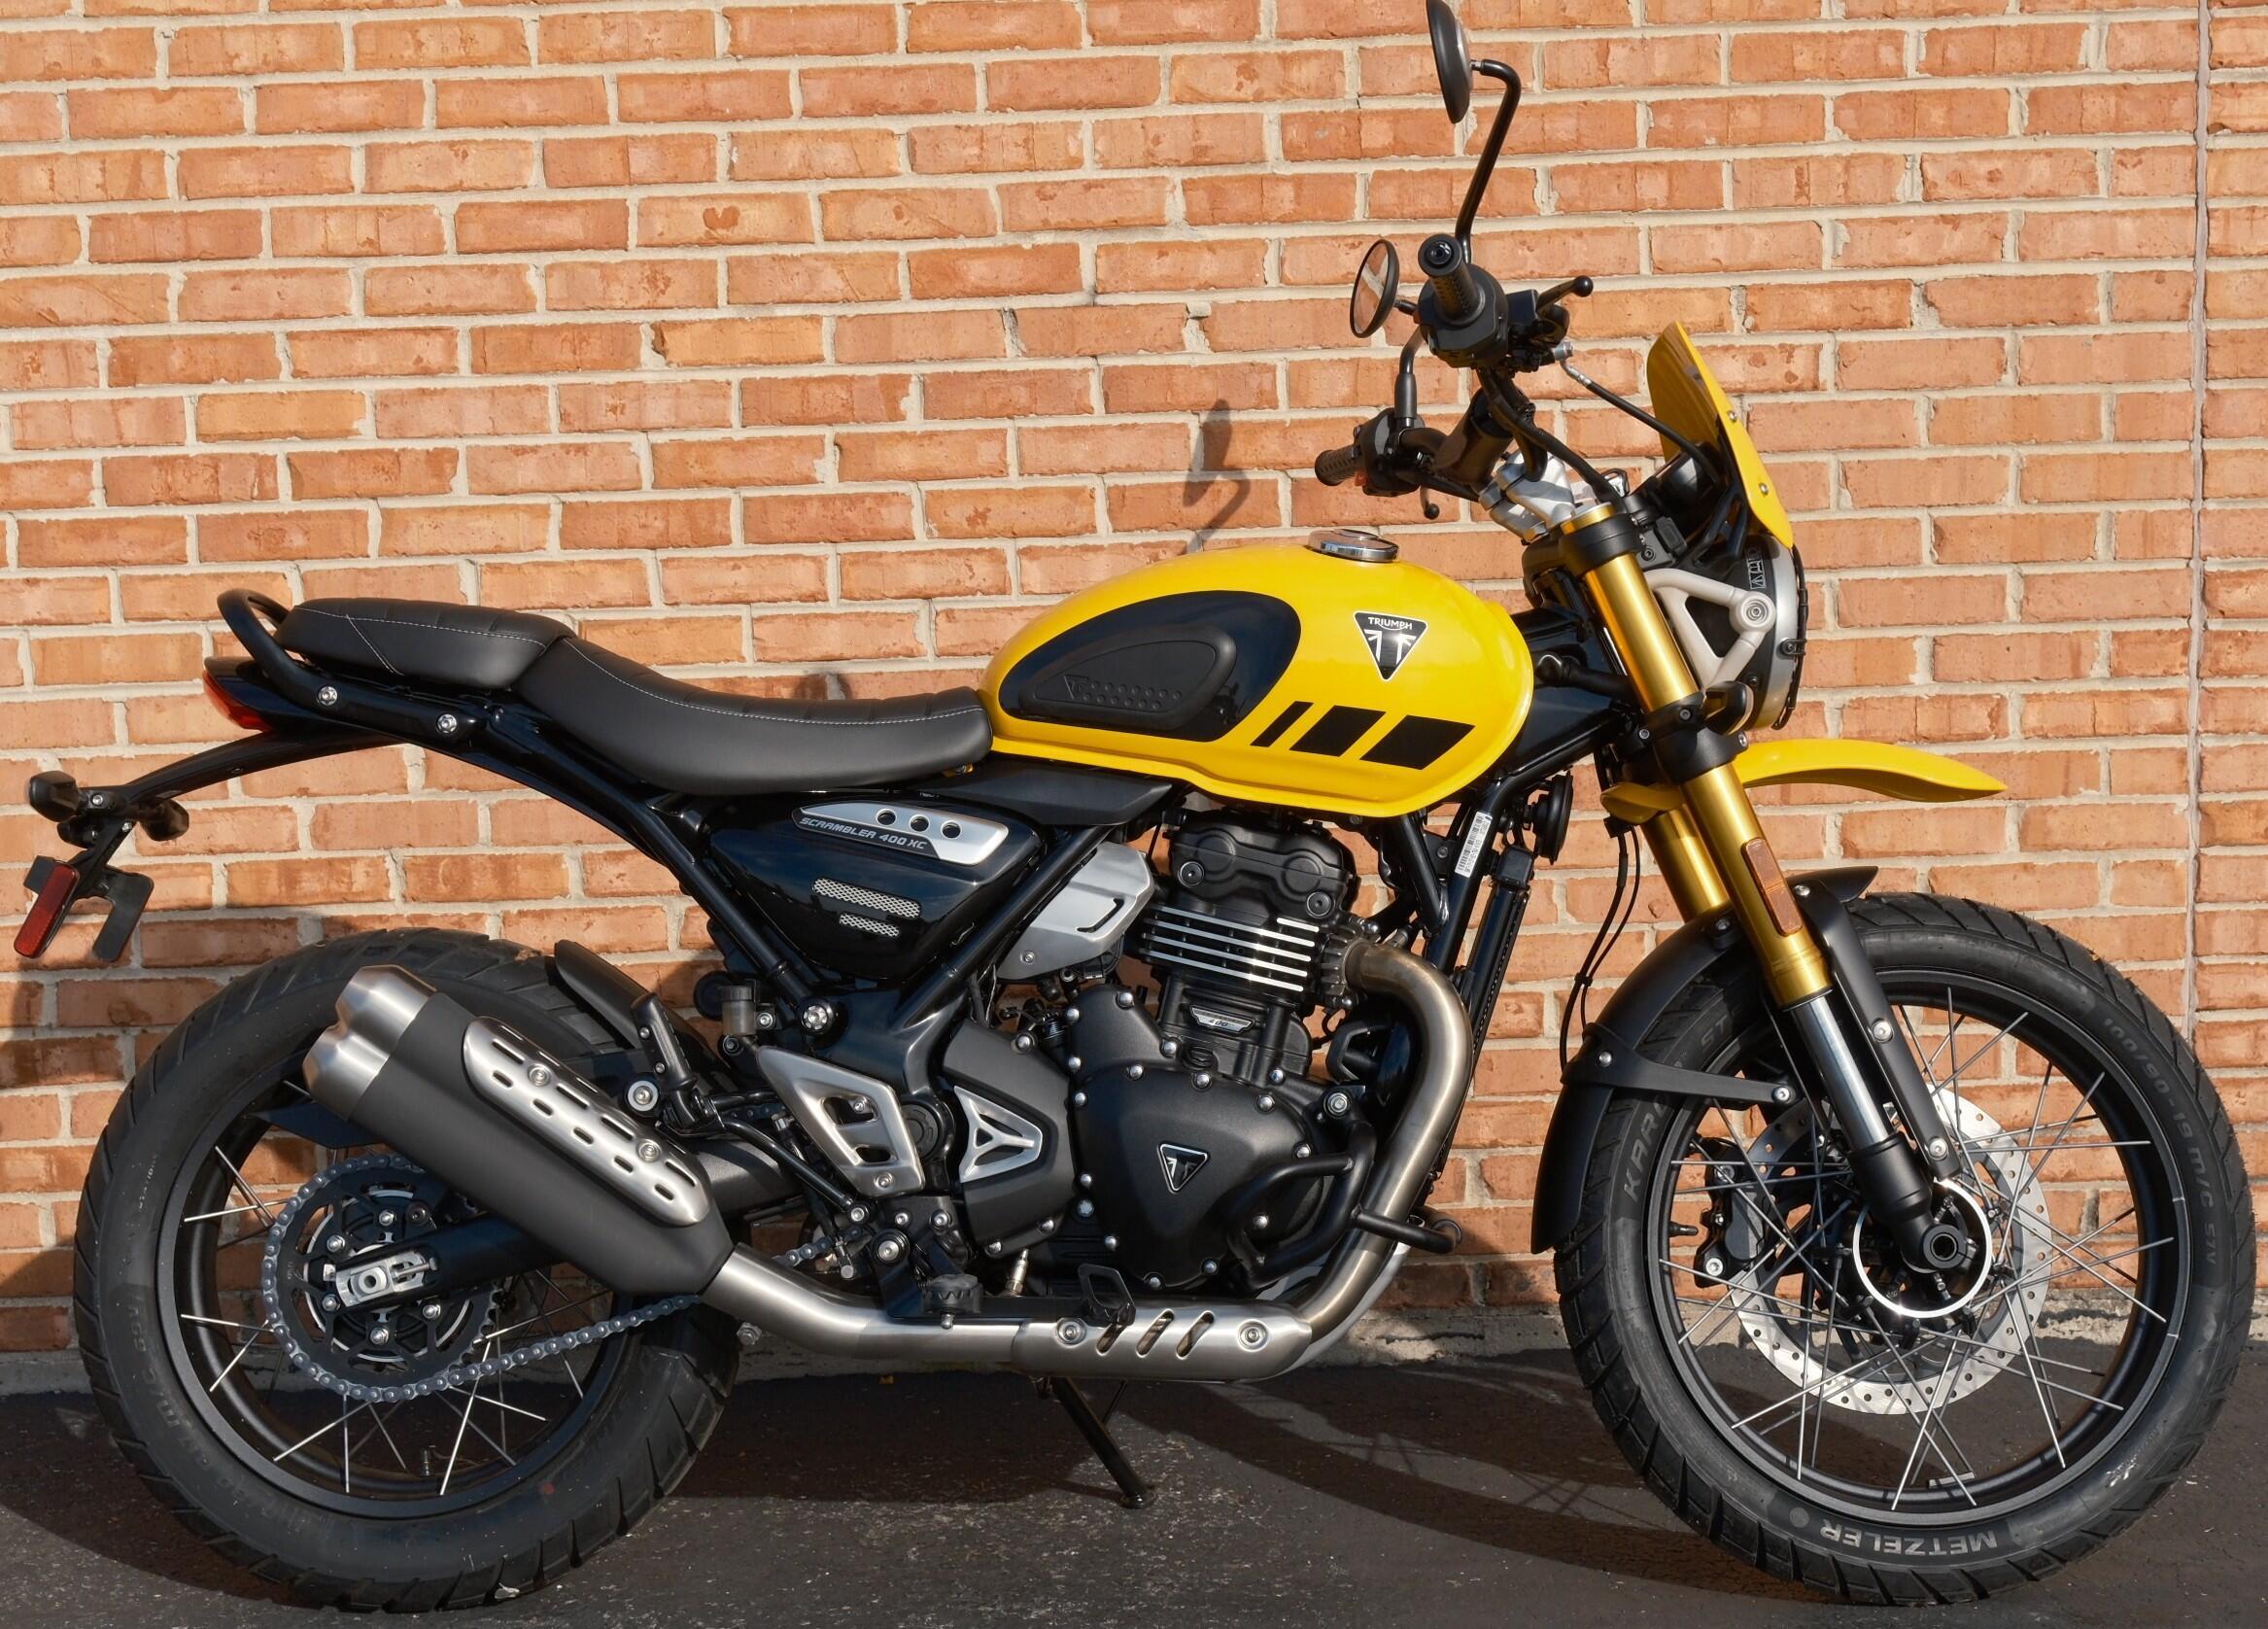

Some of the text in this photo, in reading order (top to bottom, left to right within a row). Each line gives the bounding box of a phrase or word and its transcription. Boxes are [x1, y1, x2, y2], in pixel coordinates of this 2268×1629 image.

[1367, 616, 1413, 631] TRIUMPH
[799, 816, 928, 849] SCRAMBLER 400 XC
[1818, 1517, 1998, 1556] METZELER
